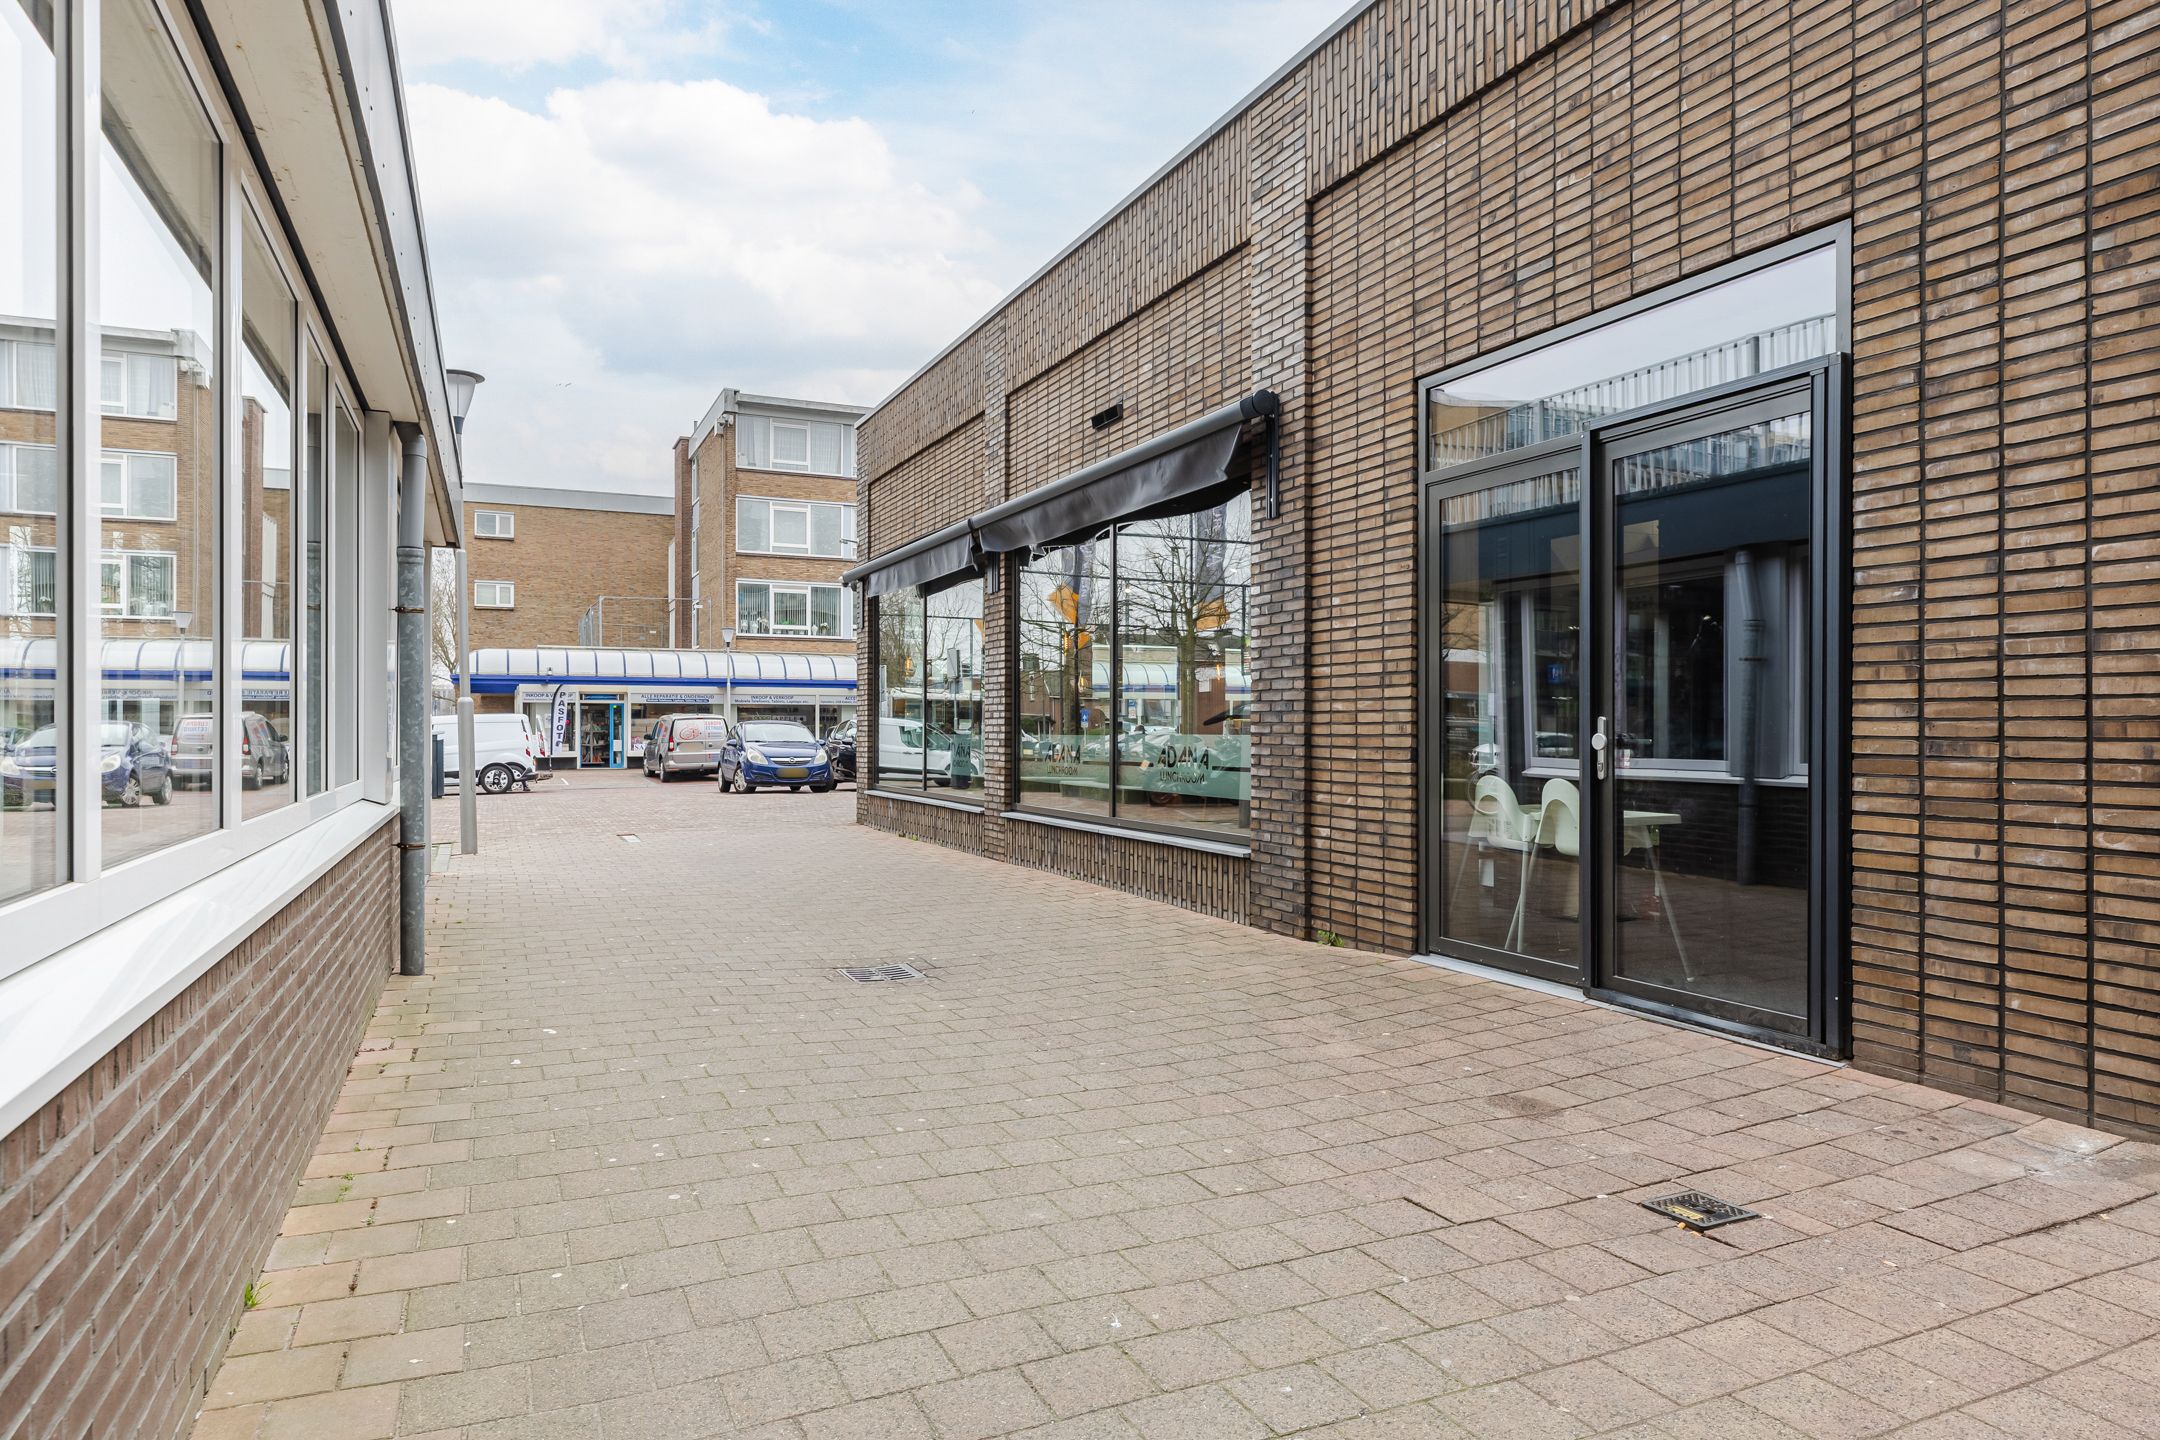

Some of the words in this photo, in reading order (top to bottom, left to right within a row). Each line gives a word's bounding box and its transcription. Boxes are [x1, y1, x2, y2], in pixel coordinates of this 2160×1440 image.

[1044, 744, 1081, 764] ADANA
[1157, 745, 1209, 770] ADANA
[1047, 765, 1079, 776] LUNCHROOM
[1159, 771, 1205, 784] LUNCHROOM
